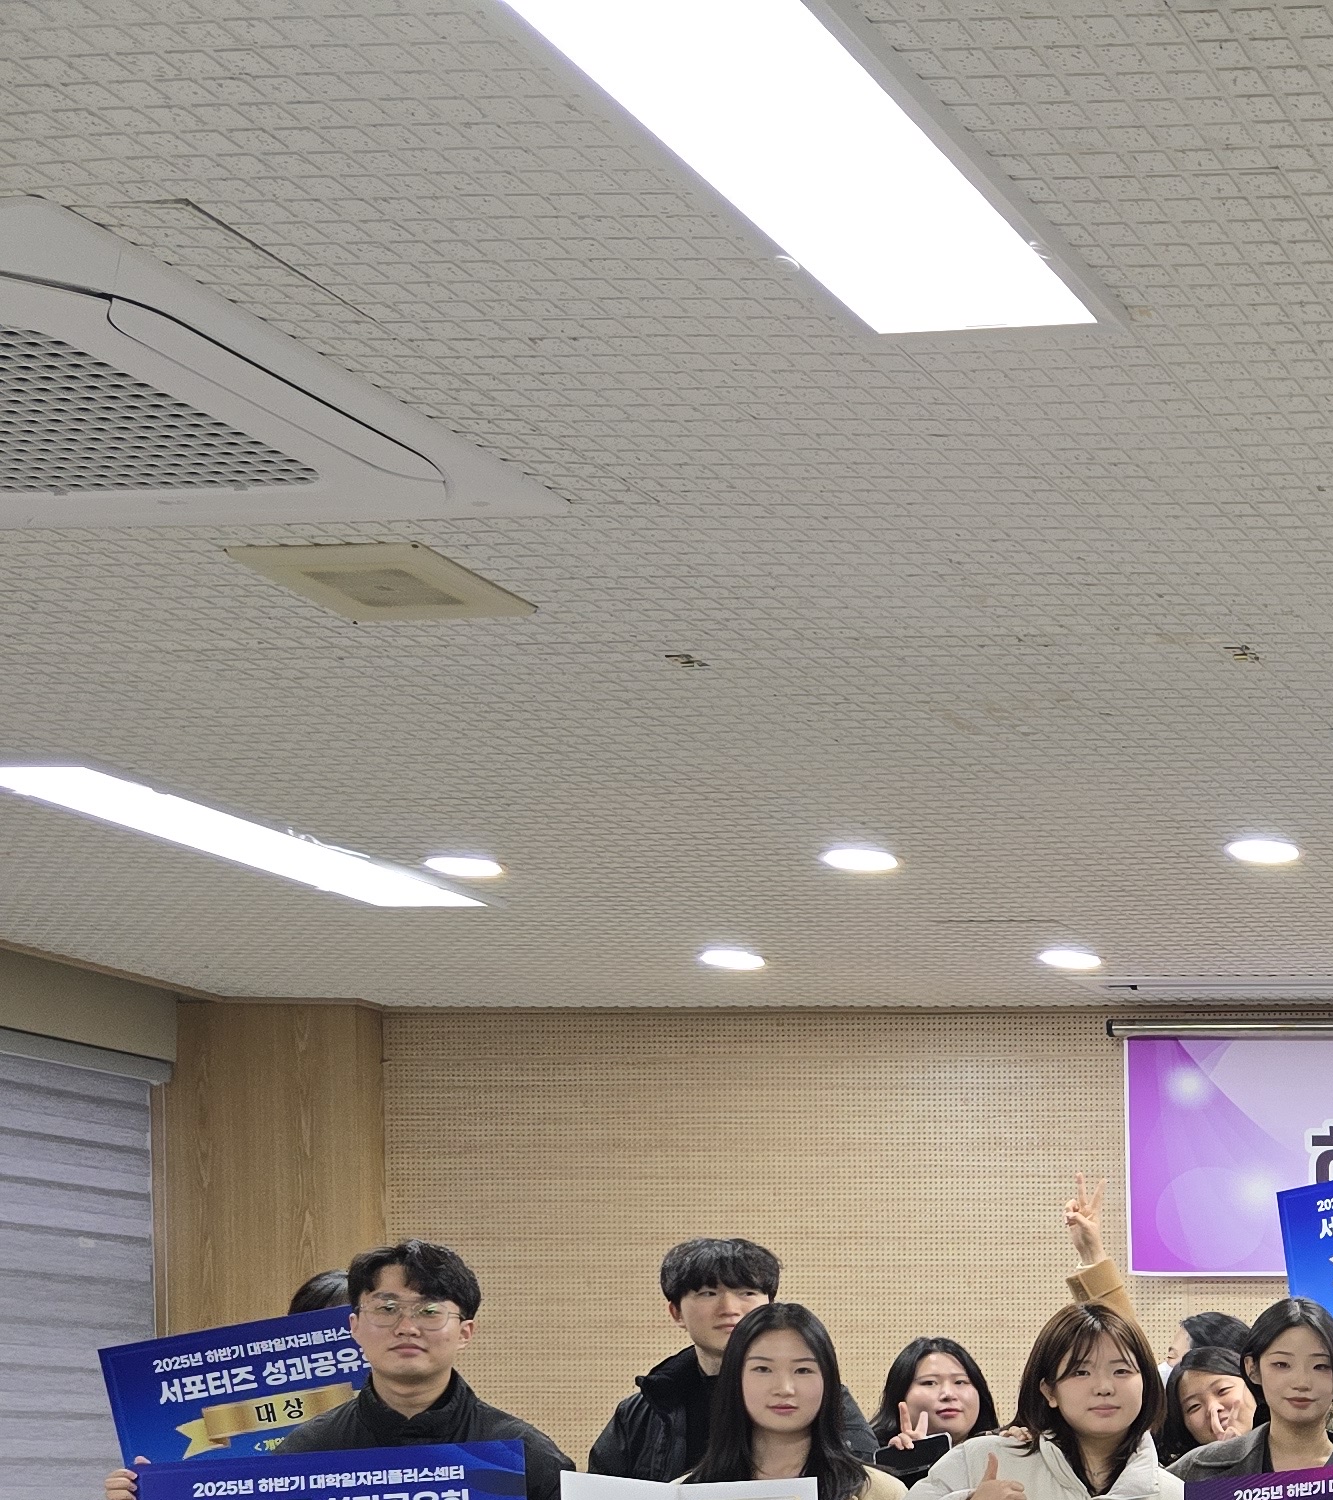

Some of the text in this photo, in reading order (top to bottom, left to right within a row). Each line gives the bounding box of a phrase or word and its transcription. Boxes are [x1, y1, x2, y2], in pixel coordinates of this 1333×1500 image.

[153, 1327, 352, 1373] 2025년 하반기 대학일자리플러스
[160, 1367, 258, 1404] 서포터즈
[192, 1465, 464, 1498] 2025년 하반기 대학일자리플러스센터
[1286, 1480, 1325, 1498] 하반기
